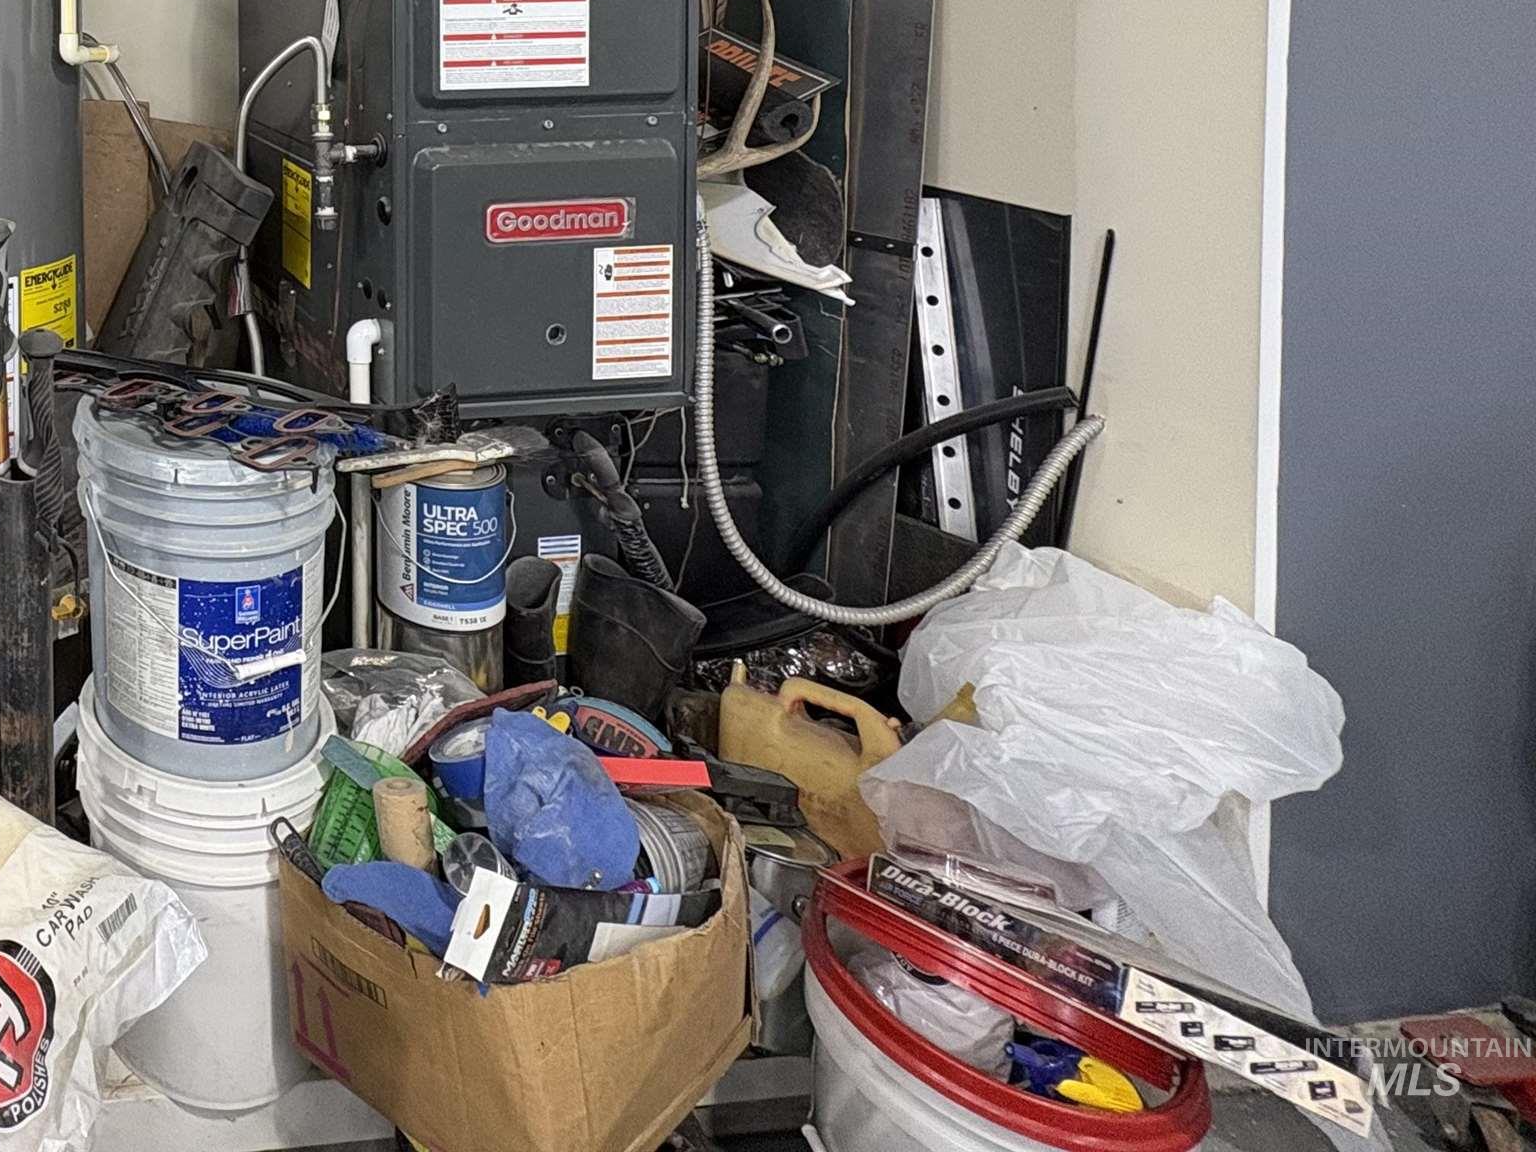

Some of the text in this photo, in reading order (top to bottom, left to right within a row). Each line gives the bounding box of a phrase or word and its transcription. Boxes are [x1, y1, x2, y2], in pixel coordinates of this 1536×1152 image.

[496, 209, 618, 233] Goodman
[402, 489, 412, 527] Moore
[423, 503, 478, 521] ULTRA
[423, 517, 498, 536] SPEC 500
[182, 616, 301, 655] SuperPaint
[199, 681, 290, 700] INTERIOR ACRYLIC LATEX
[36, 876, 100, 948] CAR WASH
[880, 865, 1011, 932] Dura-Block
[64, 905, 94, 941] PAD
[1000, 937, 1022, 954] PIECE
[1022, 946, 1077, 980] DURA-BLOCK
[1077, 973, 1096, 987] KIT
[10, 1037, 50, 1123] POLISHES
